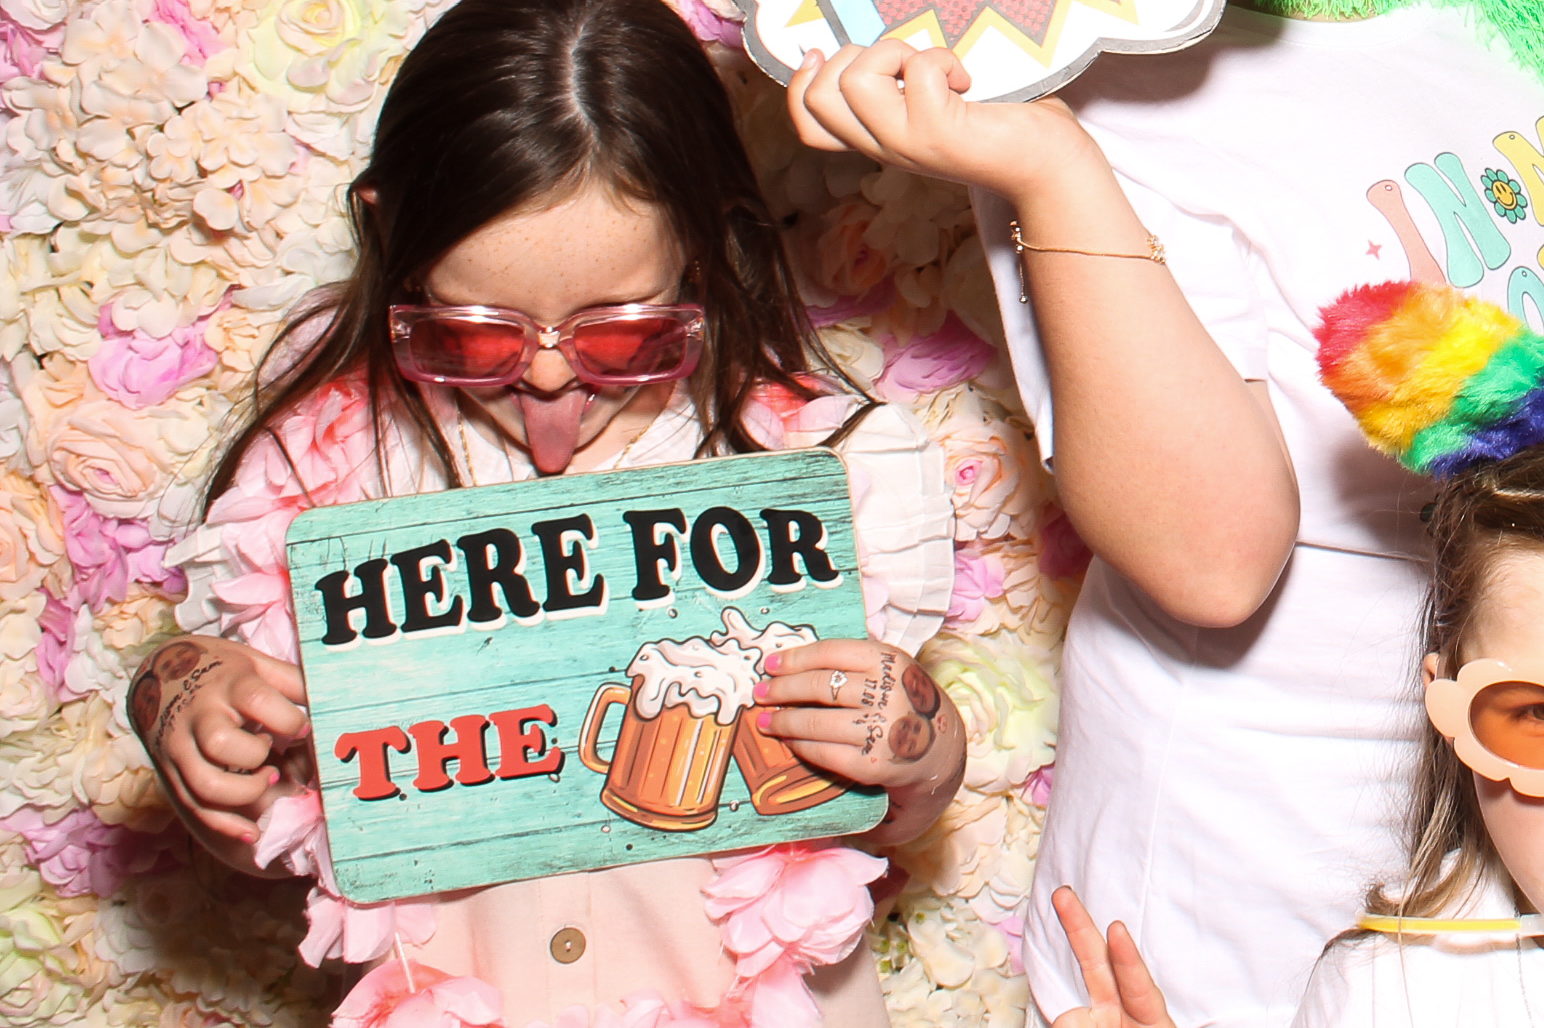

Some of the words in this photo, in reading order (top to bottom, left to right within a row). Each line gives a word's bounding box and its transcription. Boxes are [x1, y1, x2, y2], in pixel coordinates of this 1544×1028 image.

[314, 513, 608, 646] HERE
[622, 506, 840, 608] FOR
[334, 704, 566, 801] THE
